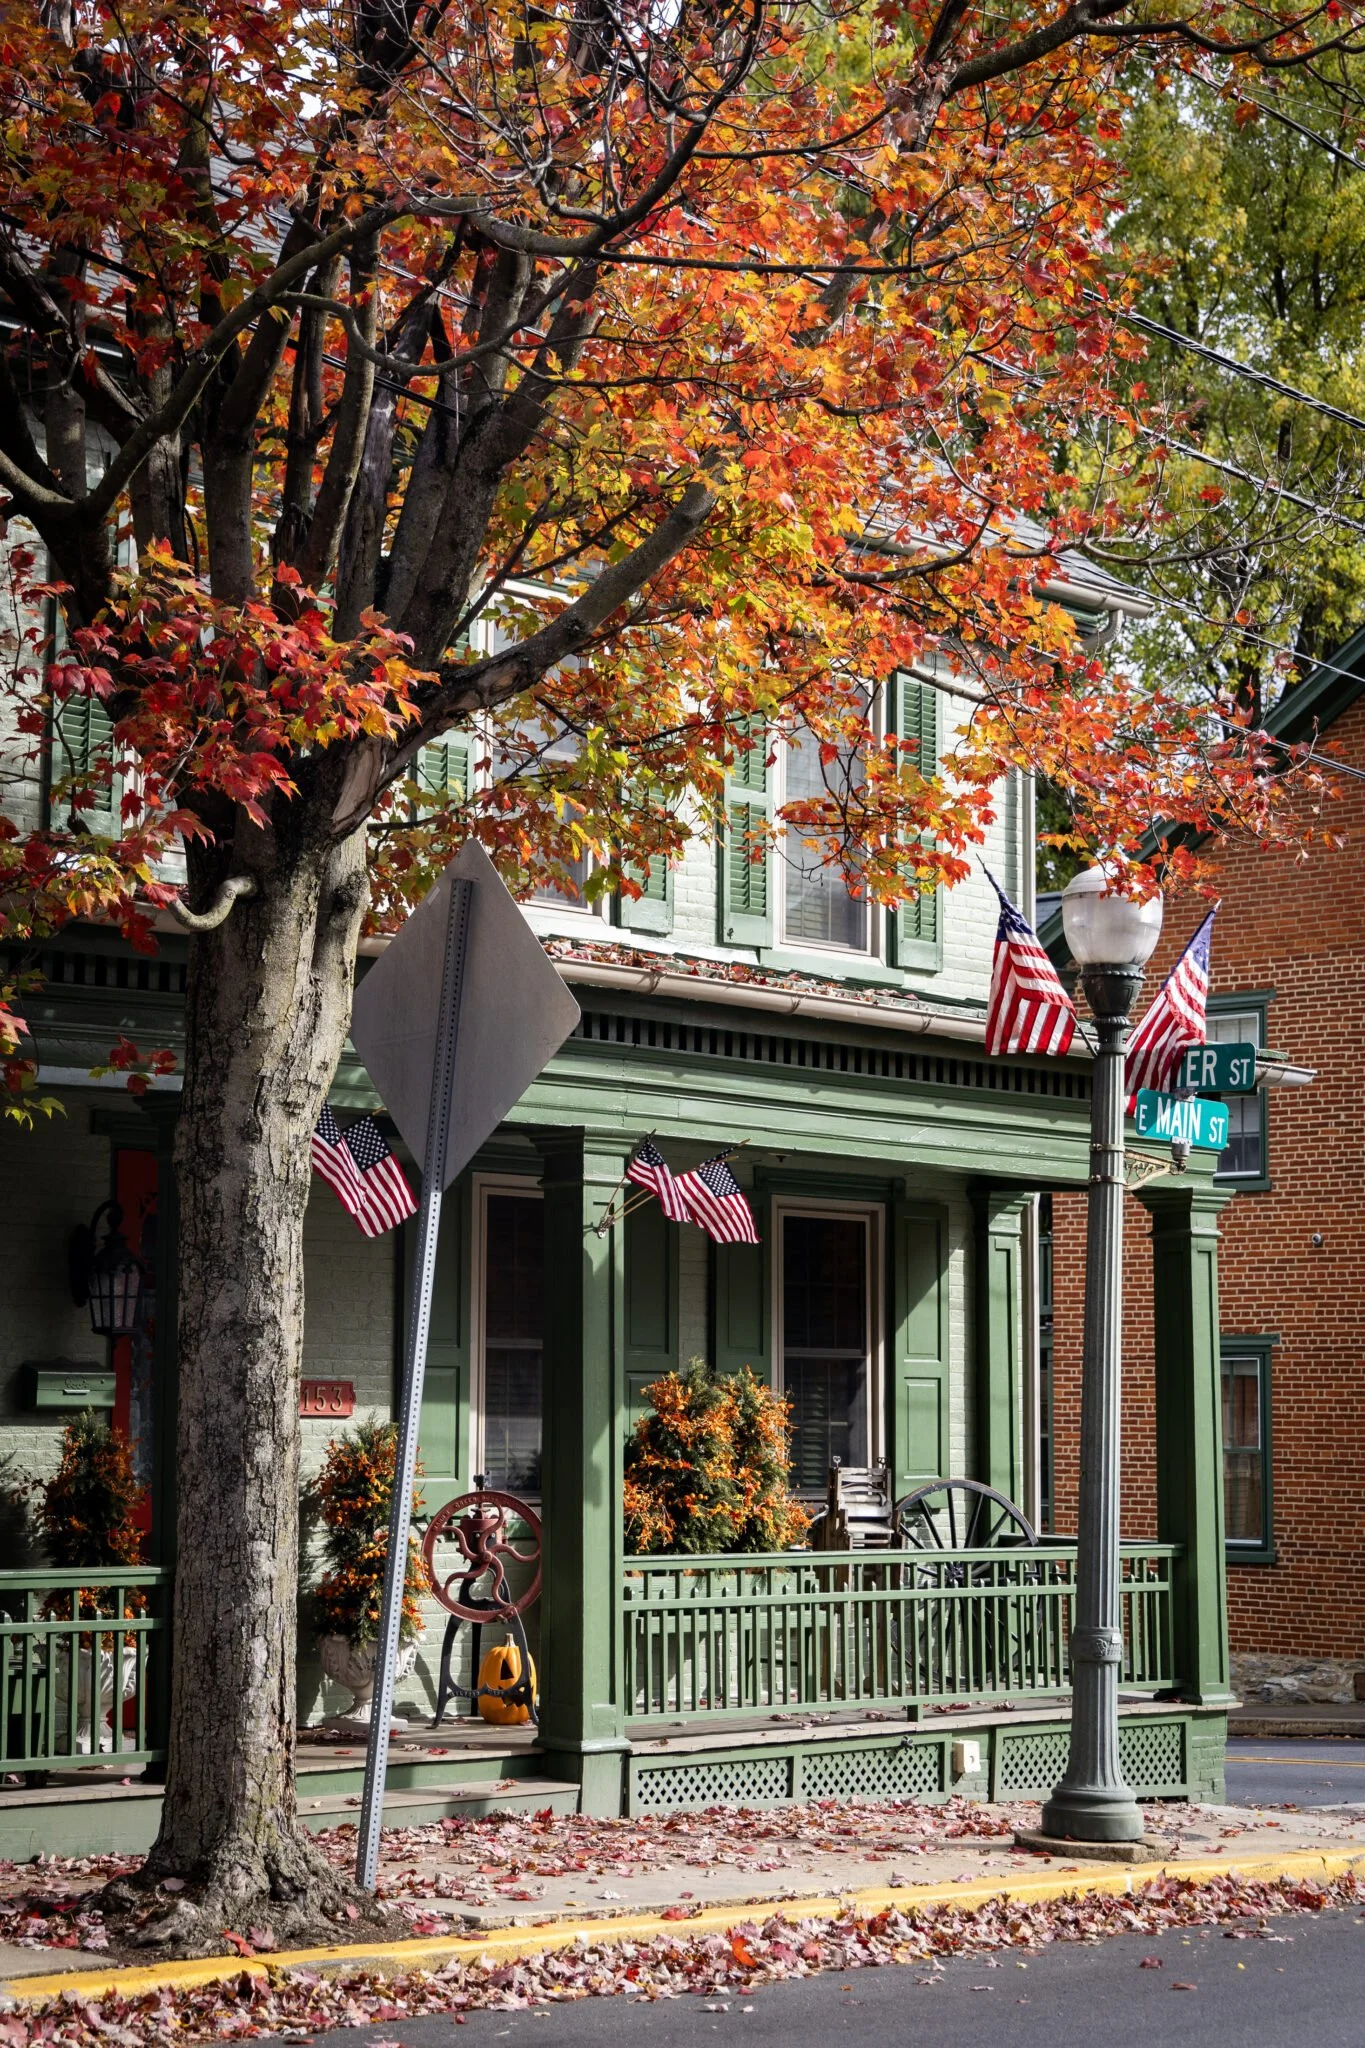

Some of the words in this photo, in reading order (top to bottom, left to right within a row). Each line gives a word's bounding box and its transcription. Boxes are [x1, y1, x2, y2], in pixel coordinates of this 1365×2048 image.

[1229, 1058, 1250, 1086] ST
[1138, 1104, 1148, 1130] E
[1156, 1096, 1201, 1140] MAIN
[1209, 1116, 1225, 1144] ST
[303, 1386, 343, 1411] 153
